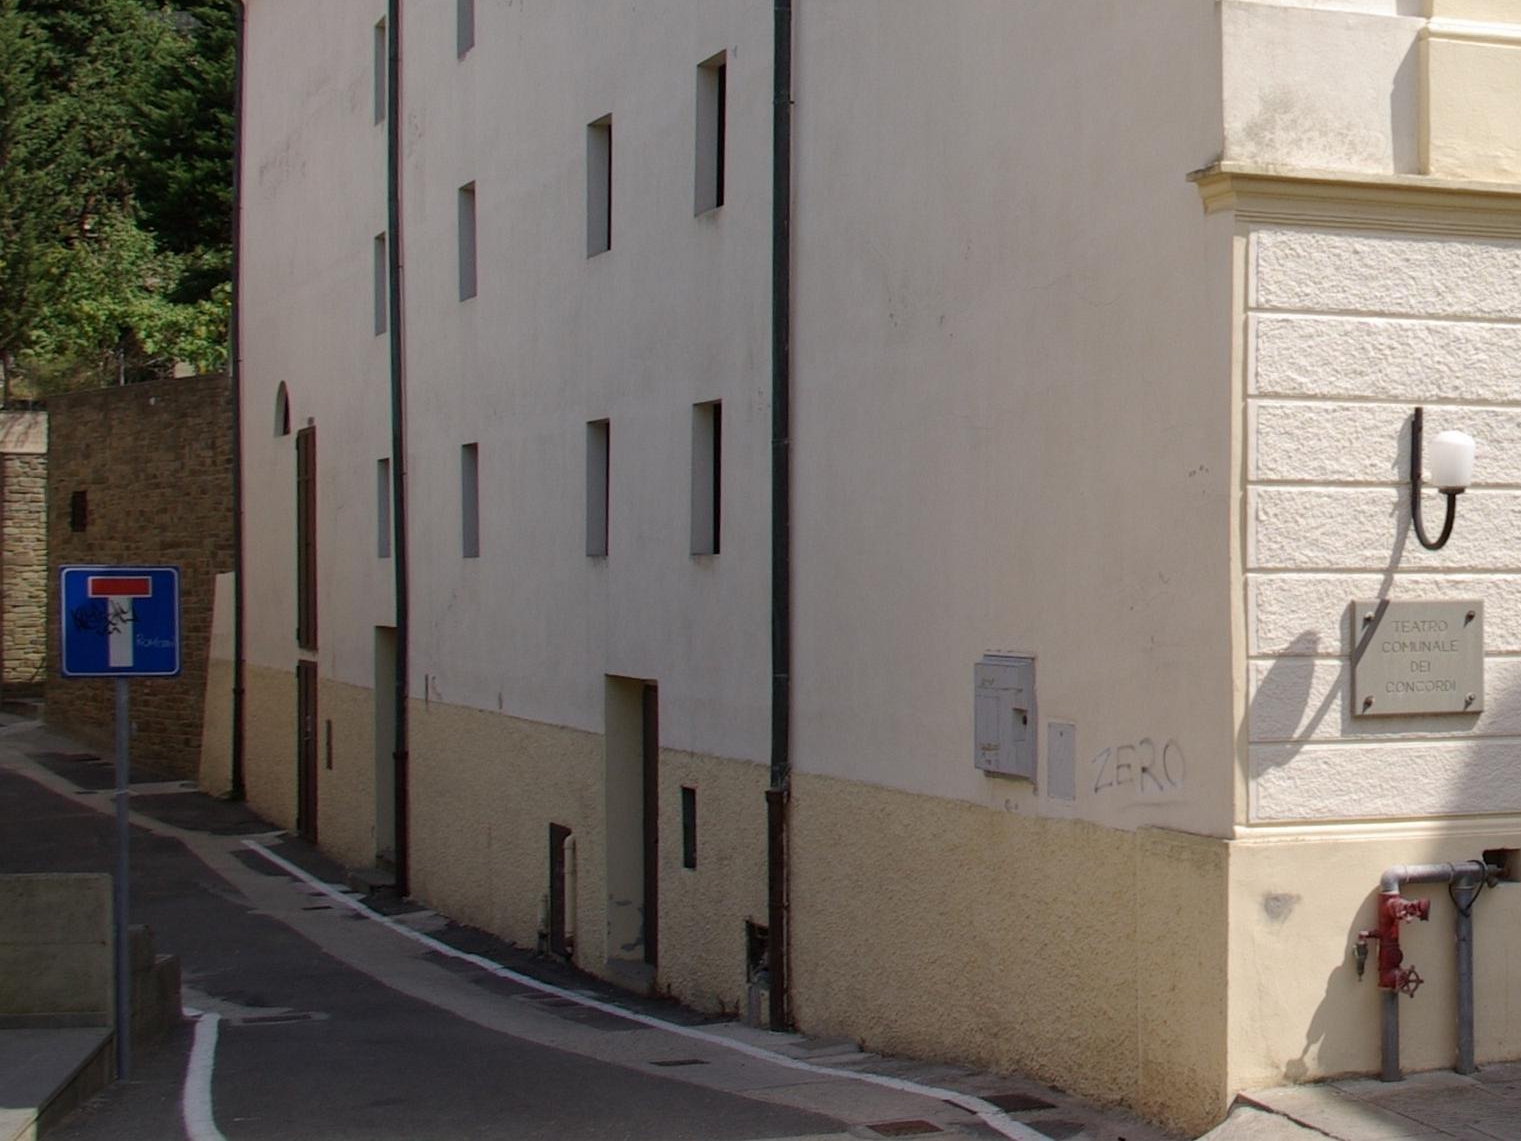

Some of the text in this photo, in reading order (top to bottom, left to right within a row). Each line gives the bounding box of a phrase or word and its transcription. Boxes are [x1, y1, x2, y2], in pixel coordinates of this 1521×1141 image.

[1393, 620, 1448, 633] TEATRO
[1382, 640, 1459, 653] COMUNALE
[1410, 660, 1431, 673] DEI
[1386, 680, 1456, 693] CONCORDI
[1092, 737, 1186, 795] ZERO
